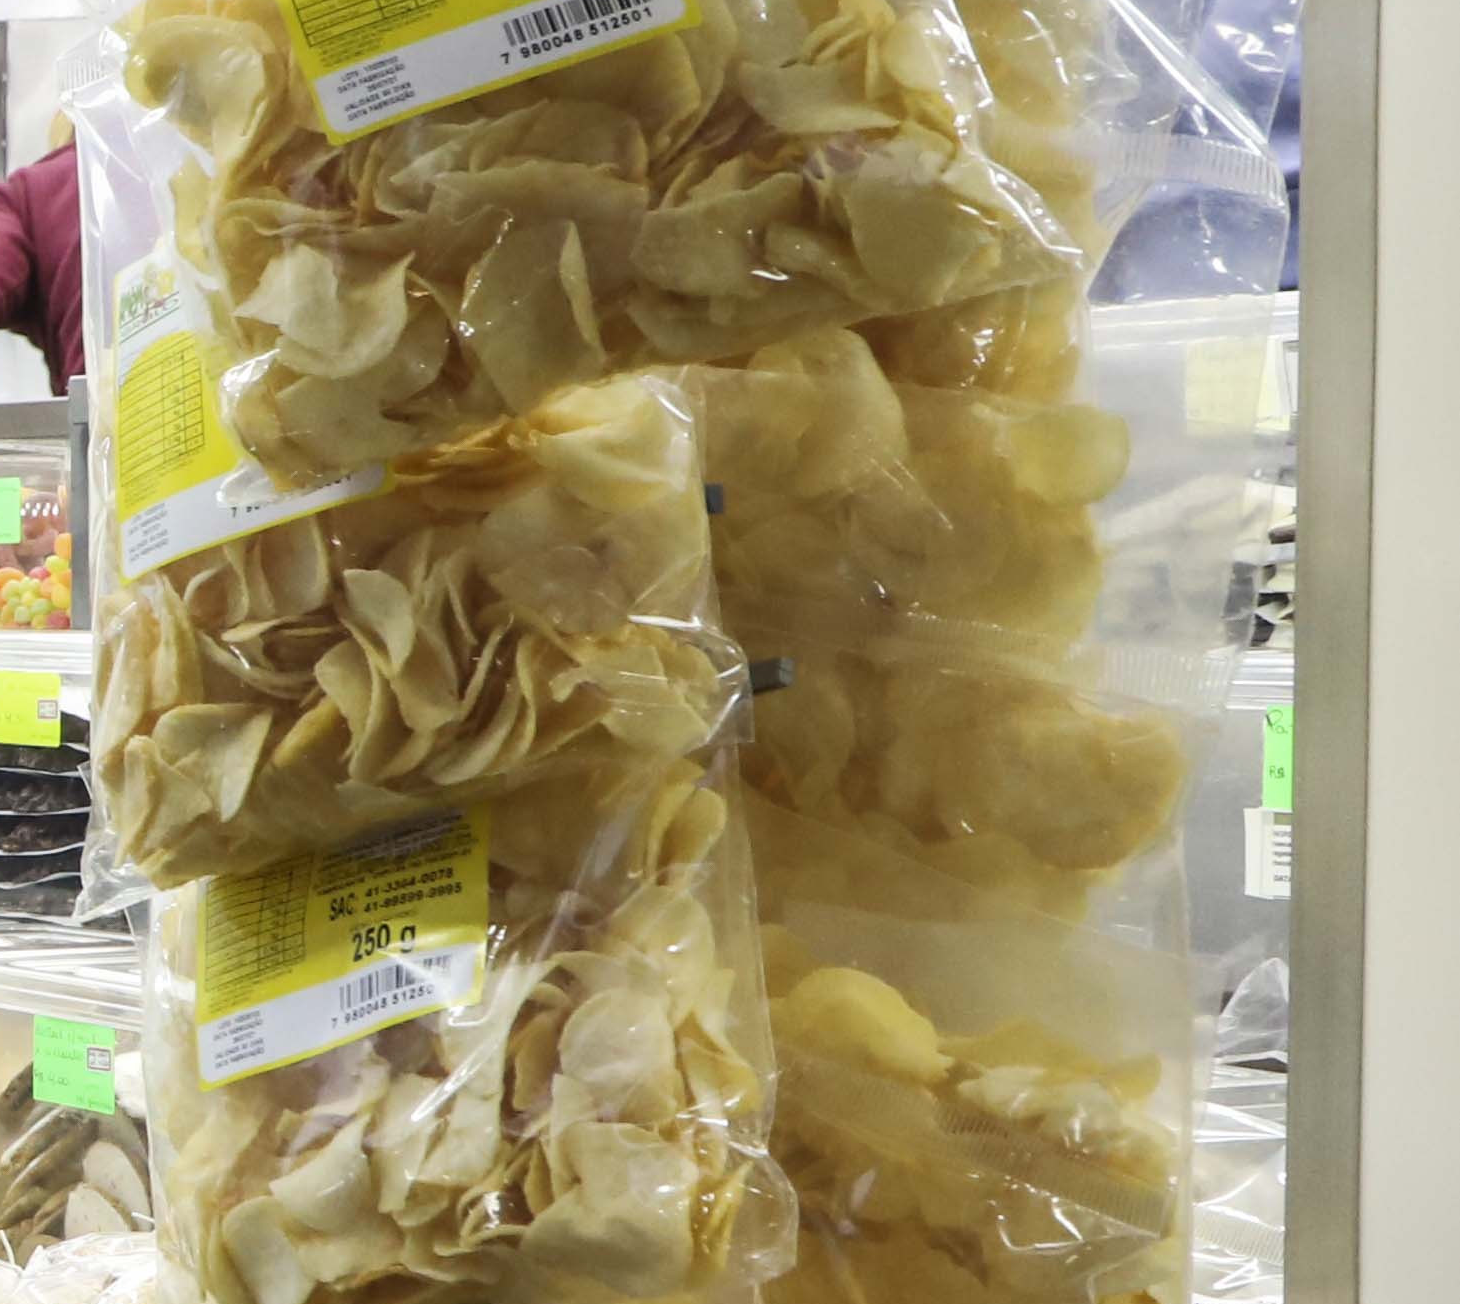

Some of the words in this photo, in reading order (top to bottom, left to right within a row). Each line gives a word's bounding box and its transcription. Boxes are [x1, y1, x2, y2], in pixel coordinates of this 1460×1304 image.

[500, 52, 511, 64] 7
[519, 28, 585, 59] 980048
[588, 6, 654, 36] 512501
[352, 923, 391, 962] 250
[400, 925, 416, 953] g
[330, 1016, 338, 1029] 7
